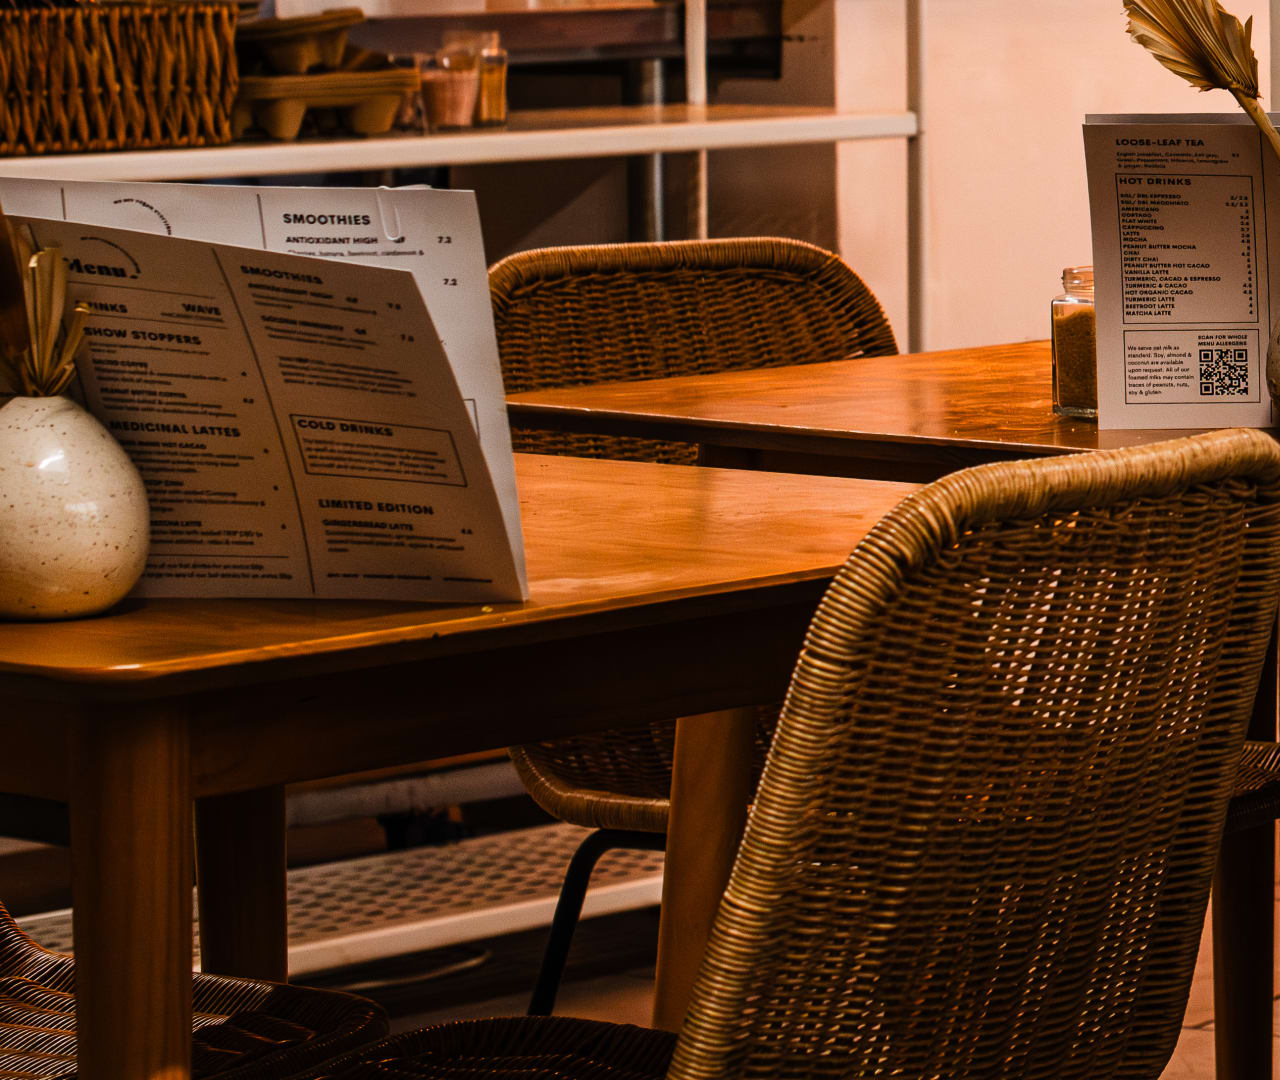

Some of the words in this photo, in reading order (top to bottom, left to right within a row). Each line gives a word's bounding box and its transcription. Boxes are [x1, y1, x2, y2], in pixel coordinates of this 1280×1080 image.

[1115, 138, 1182, 147] LOOSE-LEAF
[1184, 138, 1205, 147] TEA
[1119, 177, 1143, 185] HOT
[1147, 177, 1192, 186] DRINKS
[282, 213, 371, 226] SMOOTHIES
[285, 236, 350, 245] ANTIOXIDANT
[352, 237, 379, 245] HIGH
[437, 236, 452, 244] 7.2
[240, 265, 324, 285] SMOOTHIES
[443, 278, 458, 286] 7.2
[181, 303, 222, 316] WAVE
[83, 326, 127, 338] SHOW
[131, 330, 202, 345] STOPPERS
[109, 421, 189, 435] MEDICINAL
[192, 426, 241, 438] LATTES
[297, 419, 336, 431] COLD
[340, 422, 394, 437] DRINKS
[318, 498, 373, 511] LIMITED
[377, 503, 434, 516] EDITION
[322, 519, 387, 530] GINGERBREAD
[389, 522, 414, 531] LATTE
